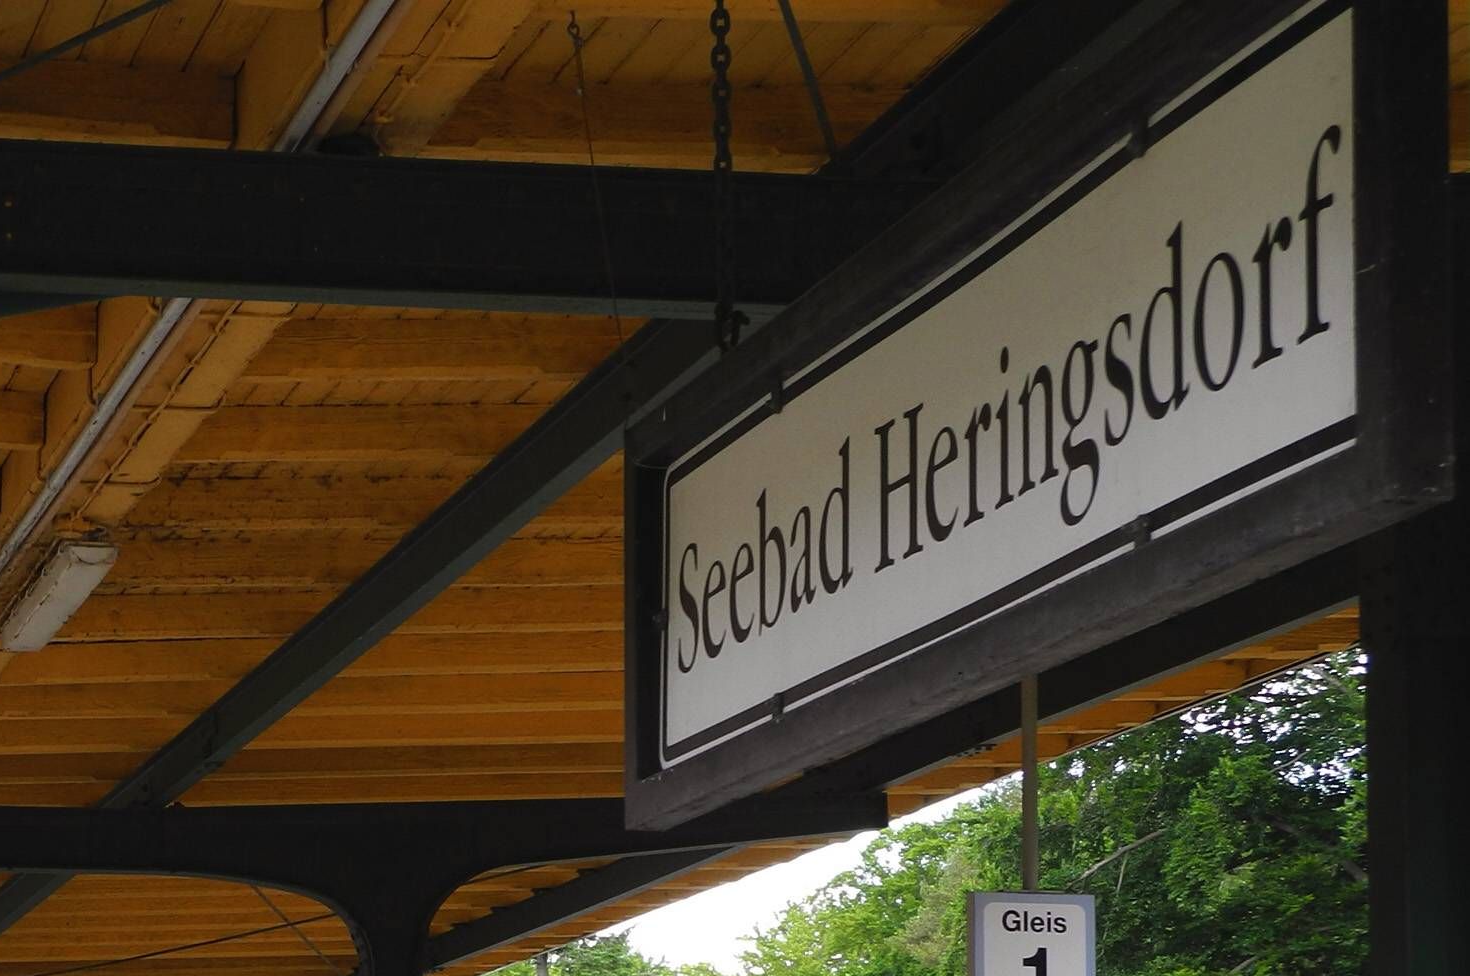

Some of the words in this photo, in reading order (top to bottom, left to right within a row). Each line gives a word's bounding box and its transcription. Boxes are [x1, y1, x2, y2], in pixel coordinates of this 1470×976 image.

[676, 436, 854, 674] Seebad
[873, 125, 1342, 574] Heringsdorf
[1001, 909, 1068, 933] Gleis
